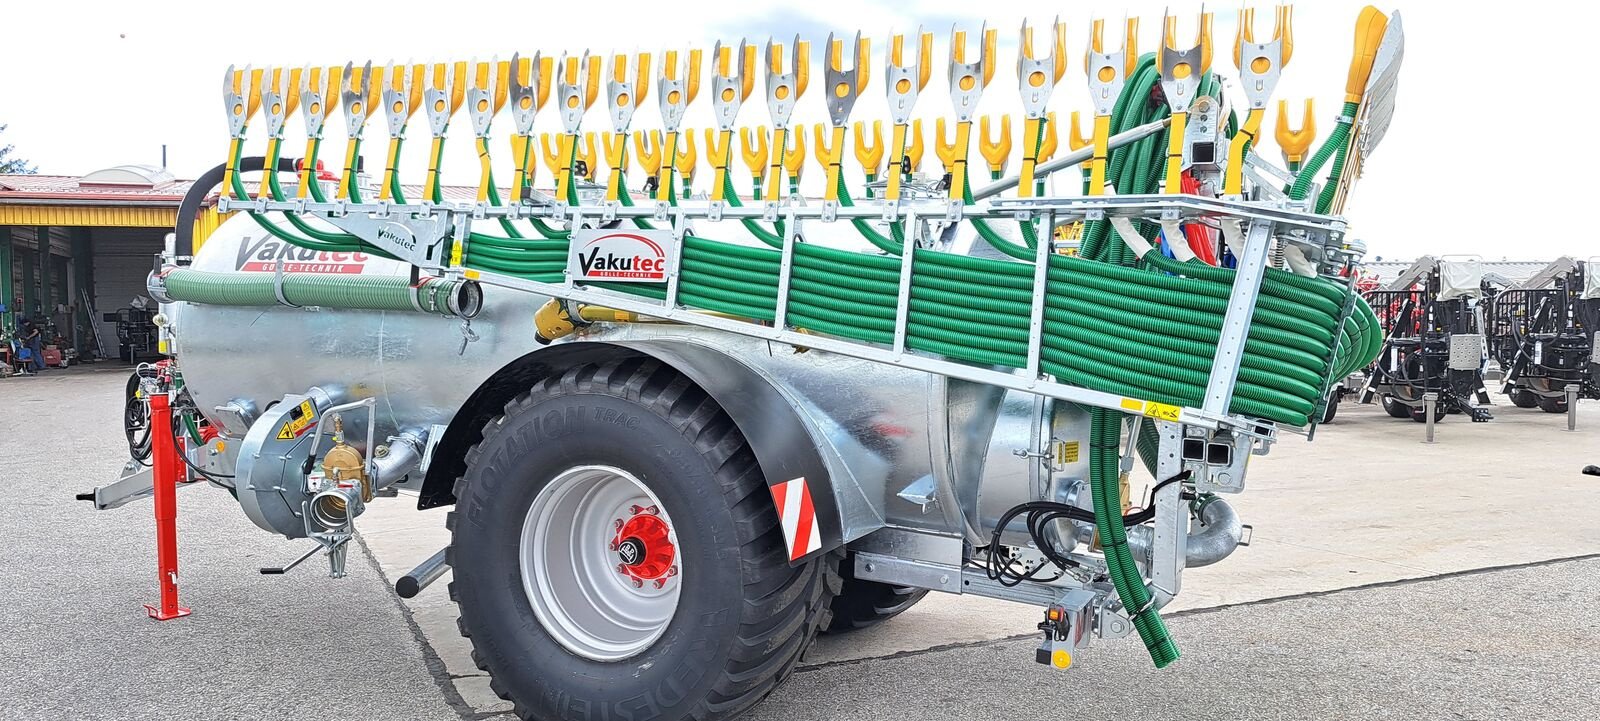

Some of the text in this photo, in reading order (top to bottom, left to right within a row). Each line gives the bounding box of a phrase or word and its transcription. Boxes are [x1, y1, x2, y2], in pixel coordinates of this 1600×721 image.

[377, 225, 416, 251] Vakutec
[578, 247, 665, 276] Vakutec
[466, 405, 586, 529] FLOTATION
[593, 406, 641, 431] TRAC
